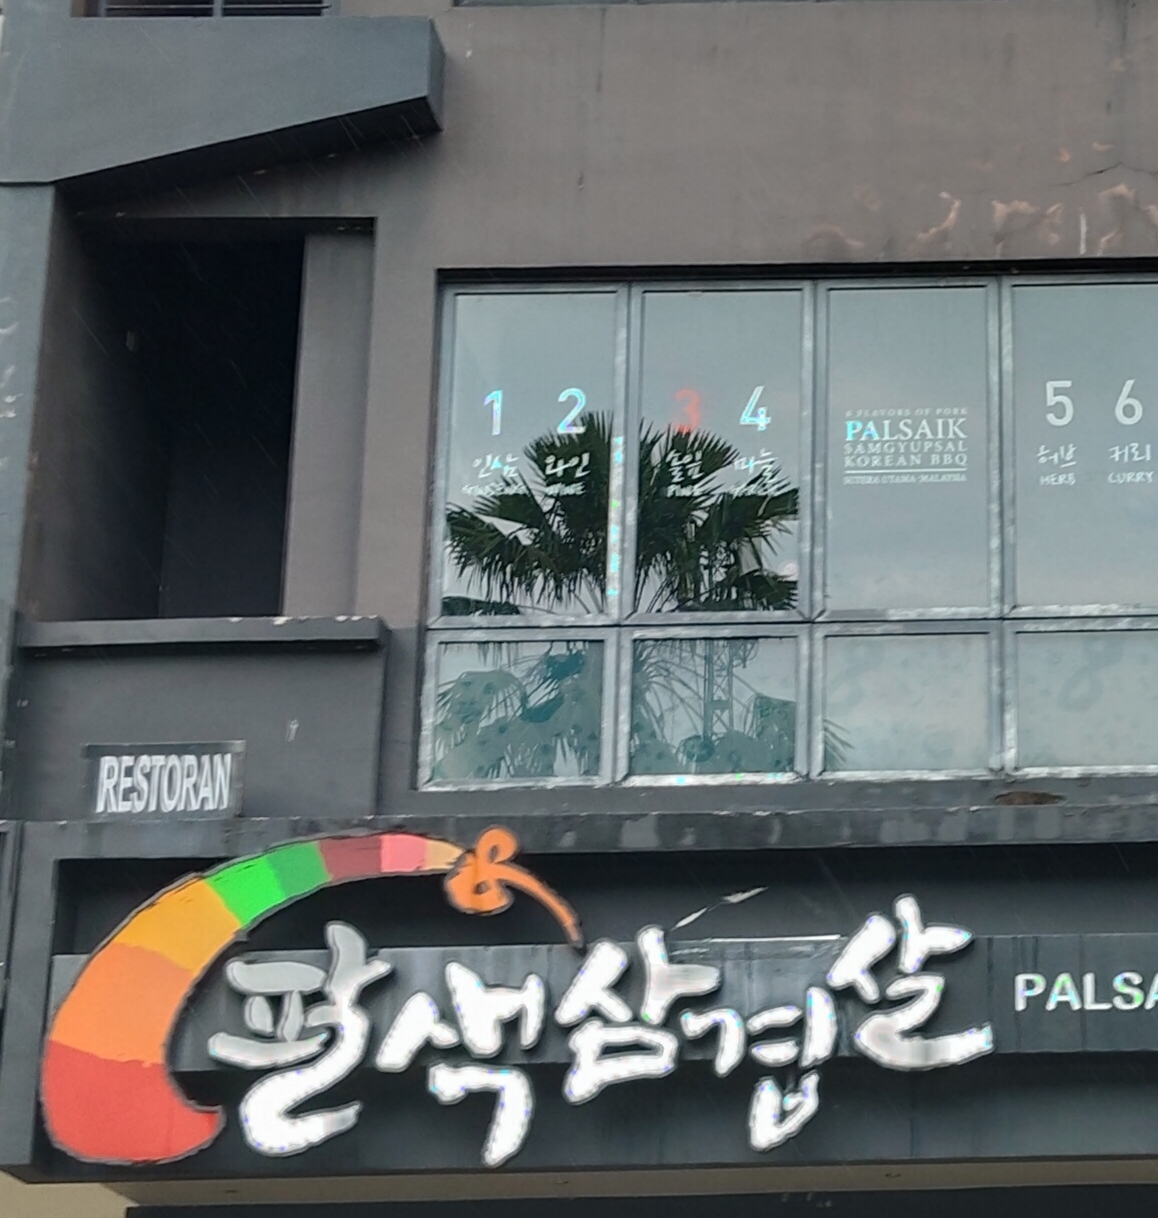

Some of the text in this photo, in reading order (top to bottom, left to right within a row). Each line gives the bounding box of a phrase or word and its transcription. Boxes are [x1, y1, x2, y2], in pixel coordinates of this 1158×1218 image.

[484, 389, 504, 436] 1
[557, 388, 586, 434] 2
[739, 386, 771, 431] 4
[1045, 380, 1074, 427] 5
[1114, 379, 1144, 426] 6
[843, 440, 968, 455] SAMGYUPSAL
[846, 418, 969, 441] PALSAIK
[843, 453, 968, 468] KOREAN BBQ
[1107, 470, 1155, 484] CURRY
[95, 753, 232, 813] RESTORAN
[208, 894, 994, 1167] 팔색삼겹살
